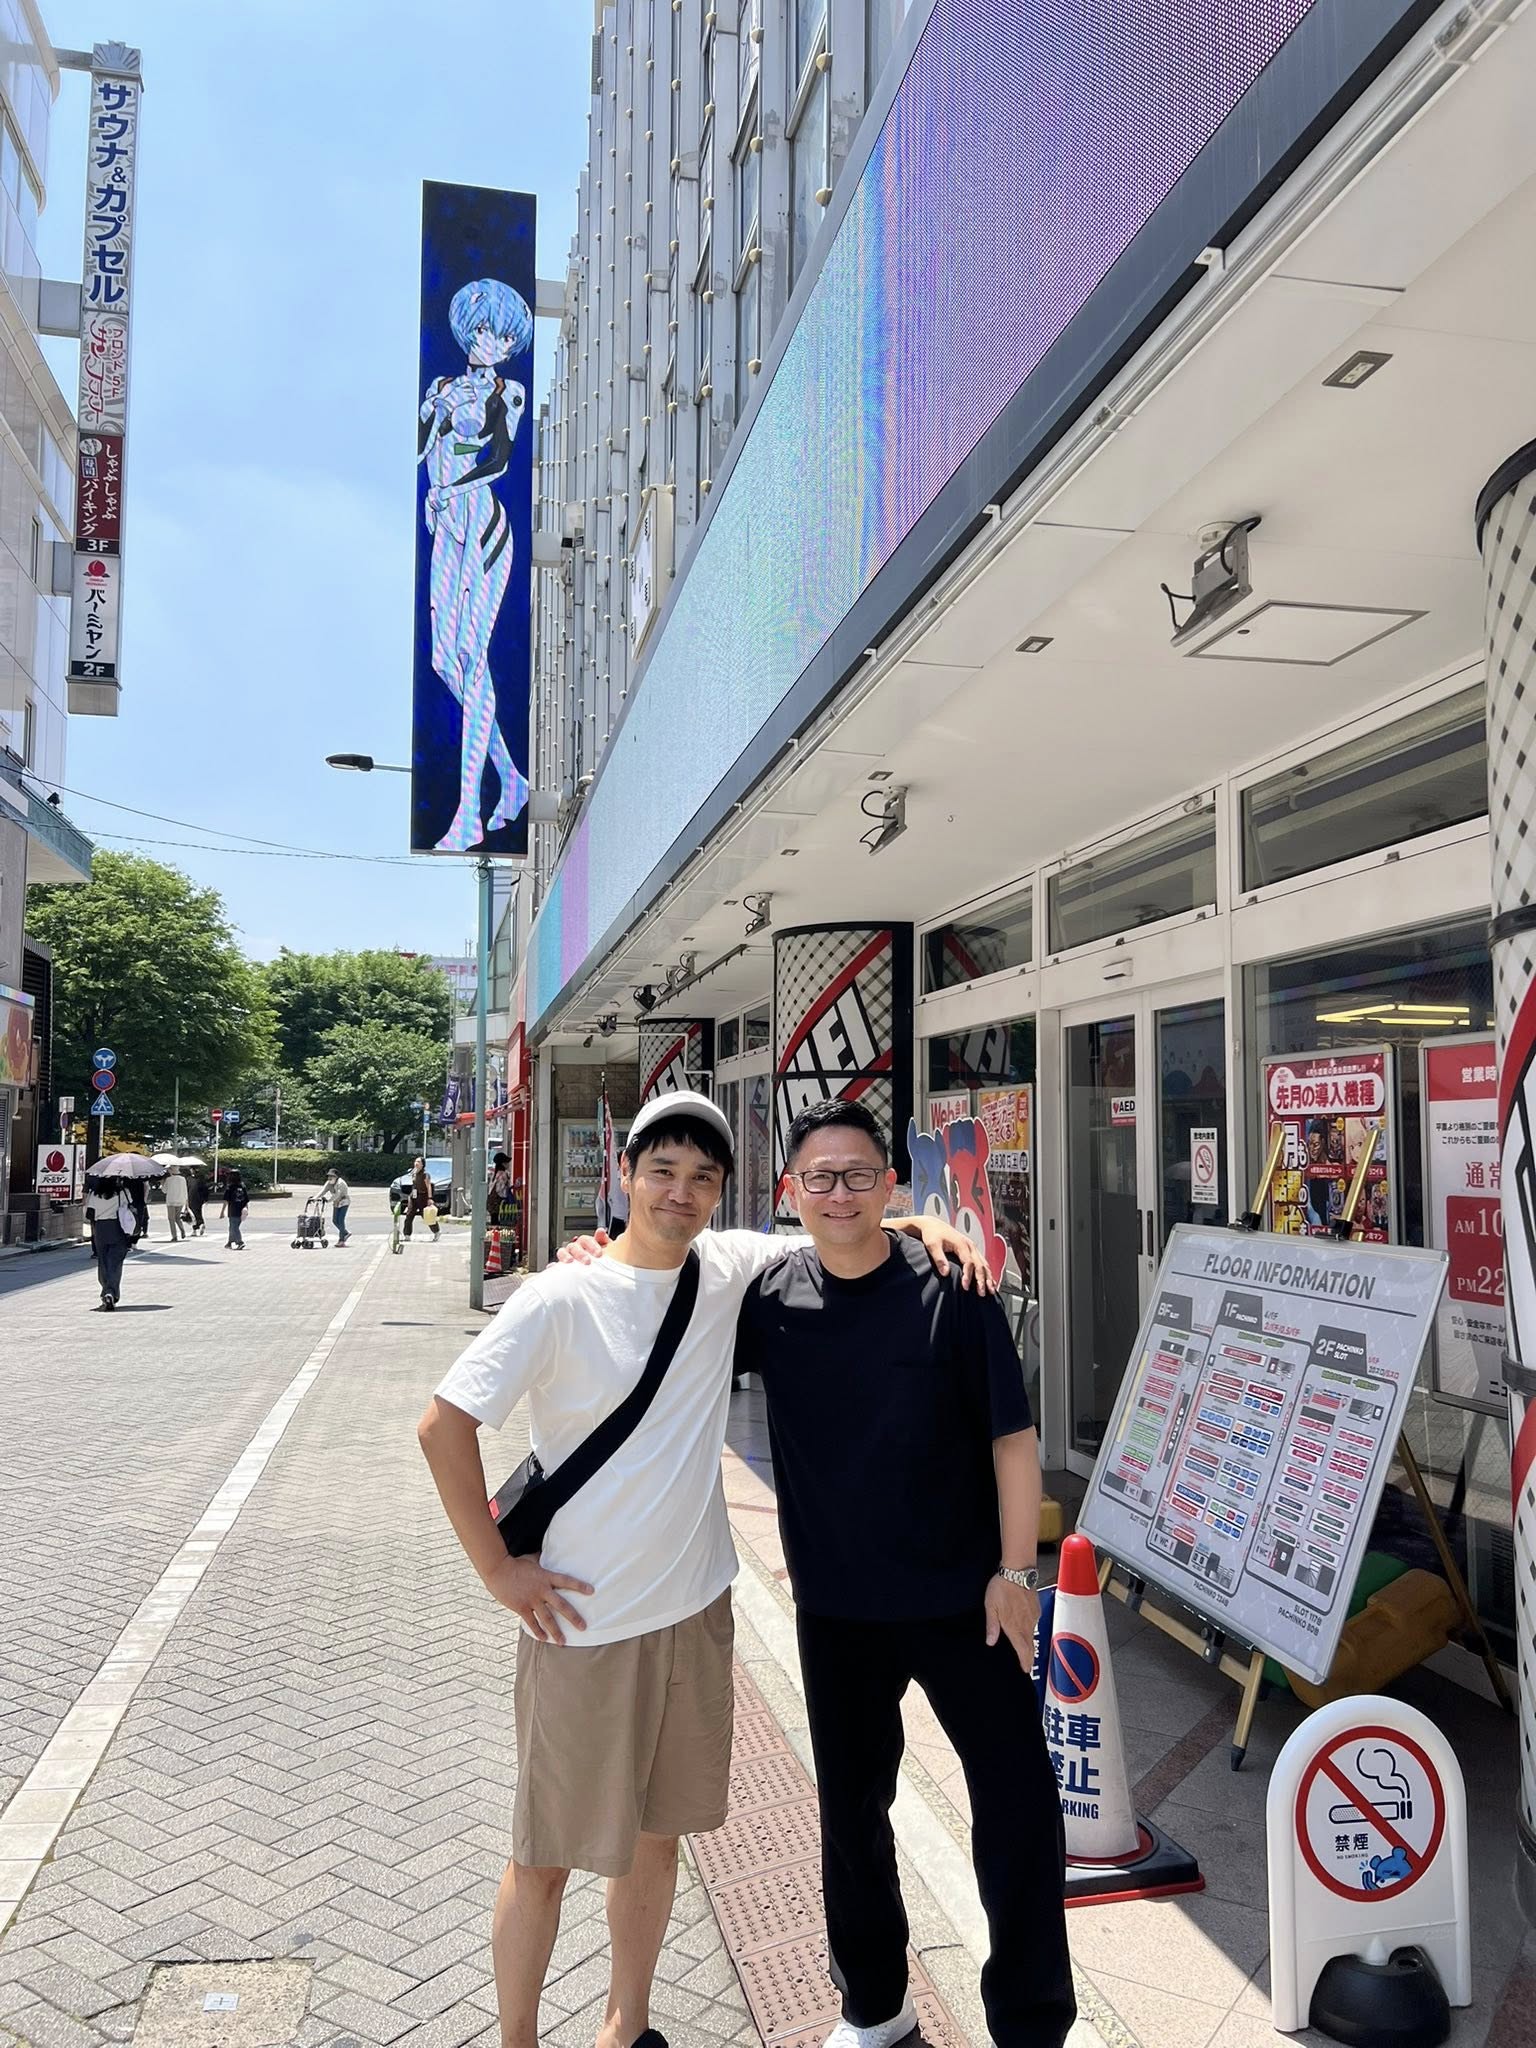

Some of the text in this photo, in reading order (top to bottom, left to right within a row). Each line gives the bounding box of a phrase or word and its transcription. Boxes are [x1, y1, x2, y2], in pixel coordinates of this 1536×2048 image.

[89, 83, 131, 303] サウナ&カプセル
[102, 443, 118, 520] しゃぶしゃぶ
[81, 479, 100, 536] バイキング
[87, 539, 109, 552] 3F
[85, 589, 106, 660] バーミヤン
[83, 663, 105, 676] 2F
[1276, 1079, 1375, 1109] 先月の導入機種
[1119, 1100, 1136, 1112] AED
[1455, 1220, 1475, 1234] AM
[1203, 1253, 1376, 1300] FLOOR INFORMATION
[1456, 1277, 1478, 1293] PM
[1224, 1302, 1239, 1318] 1F
[1316, 1338, 1364, 1357] 2F PACHINKO
[1334, 1351, 1349, 1361] SLOT
[1193, 1581, 1217, 1599] PACHINKO
[1278, 1606, 1306, 1629] PACHINKO
[1294, 1604, 1310, 1618] SLOT
[1043, 1704, 1102, 1752] 駐車
[1061, 1797, 1100, 1820] RKING
[1335, 1833, 1369, 1852] 禁煙
[1345, 1852, 1369, 1860] SMOKING
